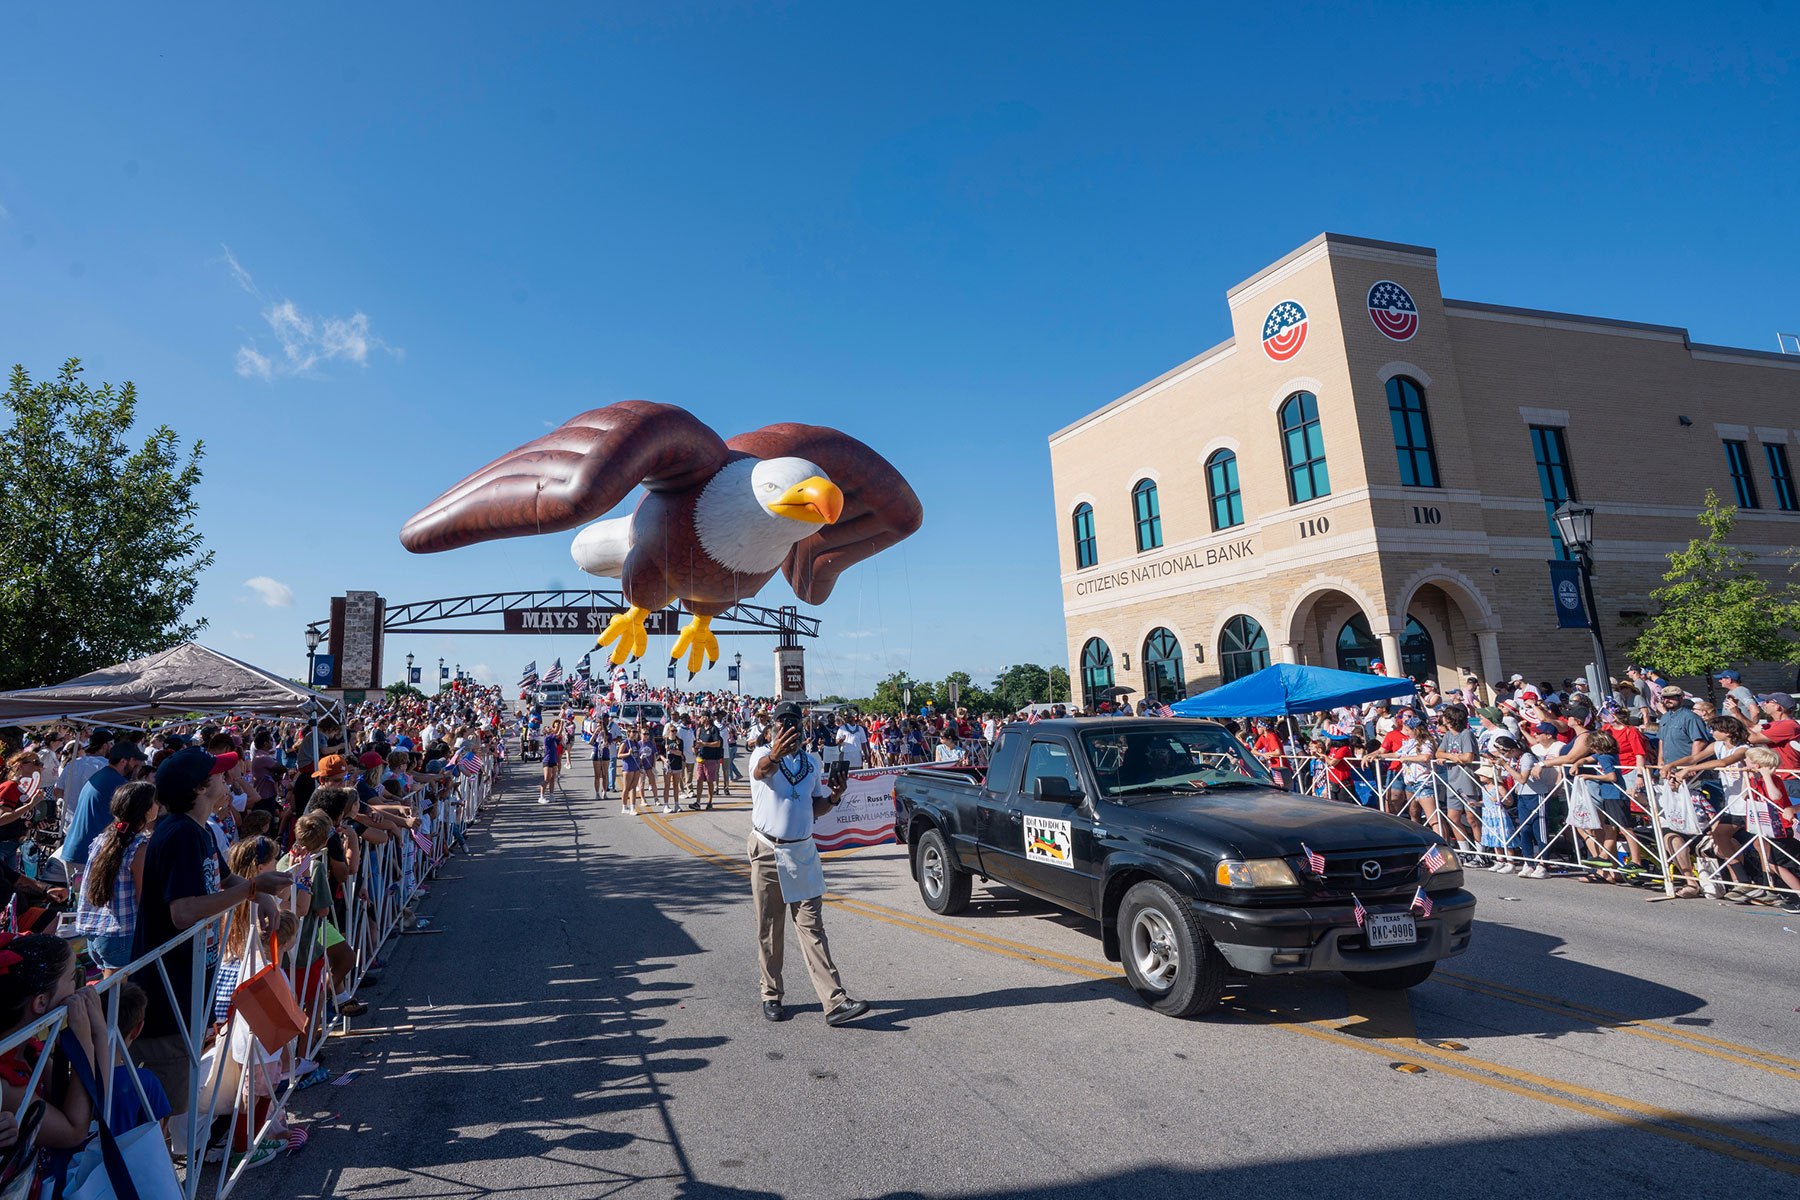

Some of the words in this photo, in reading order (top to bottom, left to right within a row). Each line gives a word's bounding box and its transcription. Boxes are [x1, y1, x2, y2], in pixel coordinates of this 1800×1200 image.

[1413, 506, 1441, 525] 110
[1299, 516, 1330, 539] 110
[1076, 571, 1129, 596] CITIZENS
[1131, 553, 1204, 584] NATIONAL
[1206, 539, 1255, 566] BANK
[521, 611, 579, 629] MAYS
[586, 612, 663, 629] STT
[866, 795, 883, 803] Russ
[1026, 817, 1047, 828] ROUND
[1048, 821, 1067, 831] ROCK
